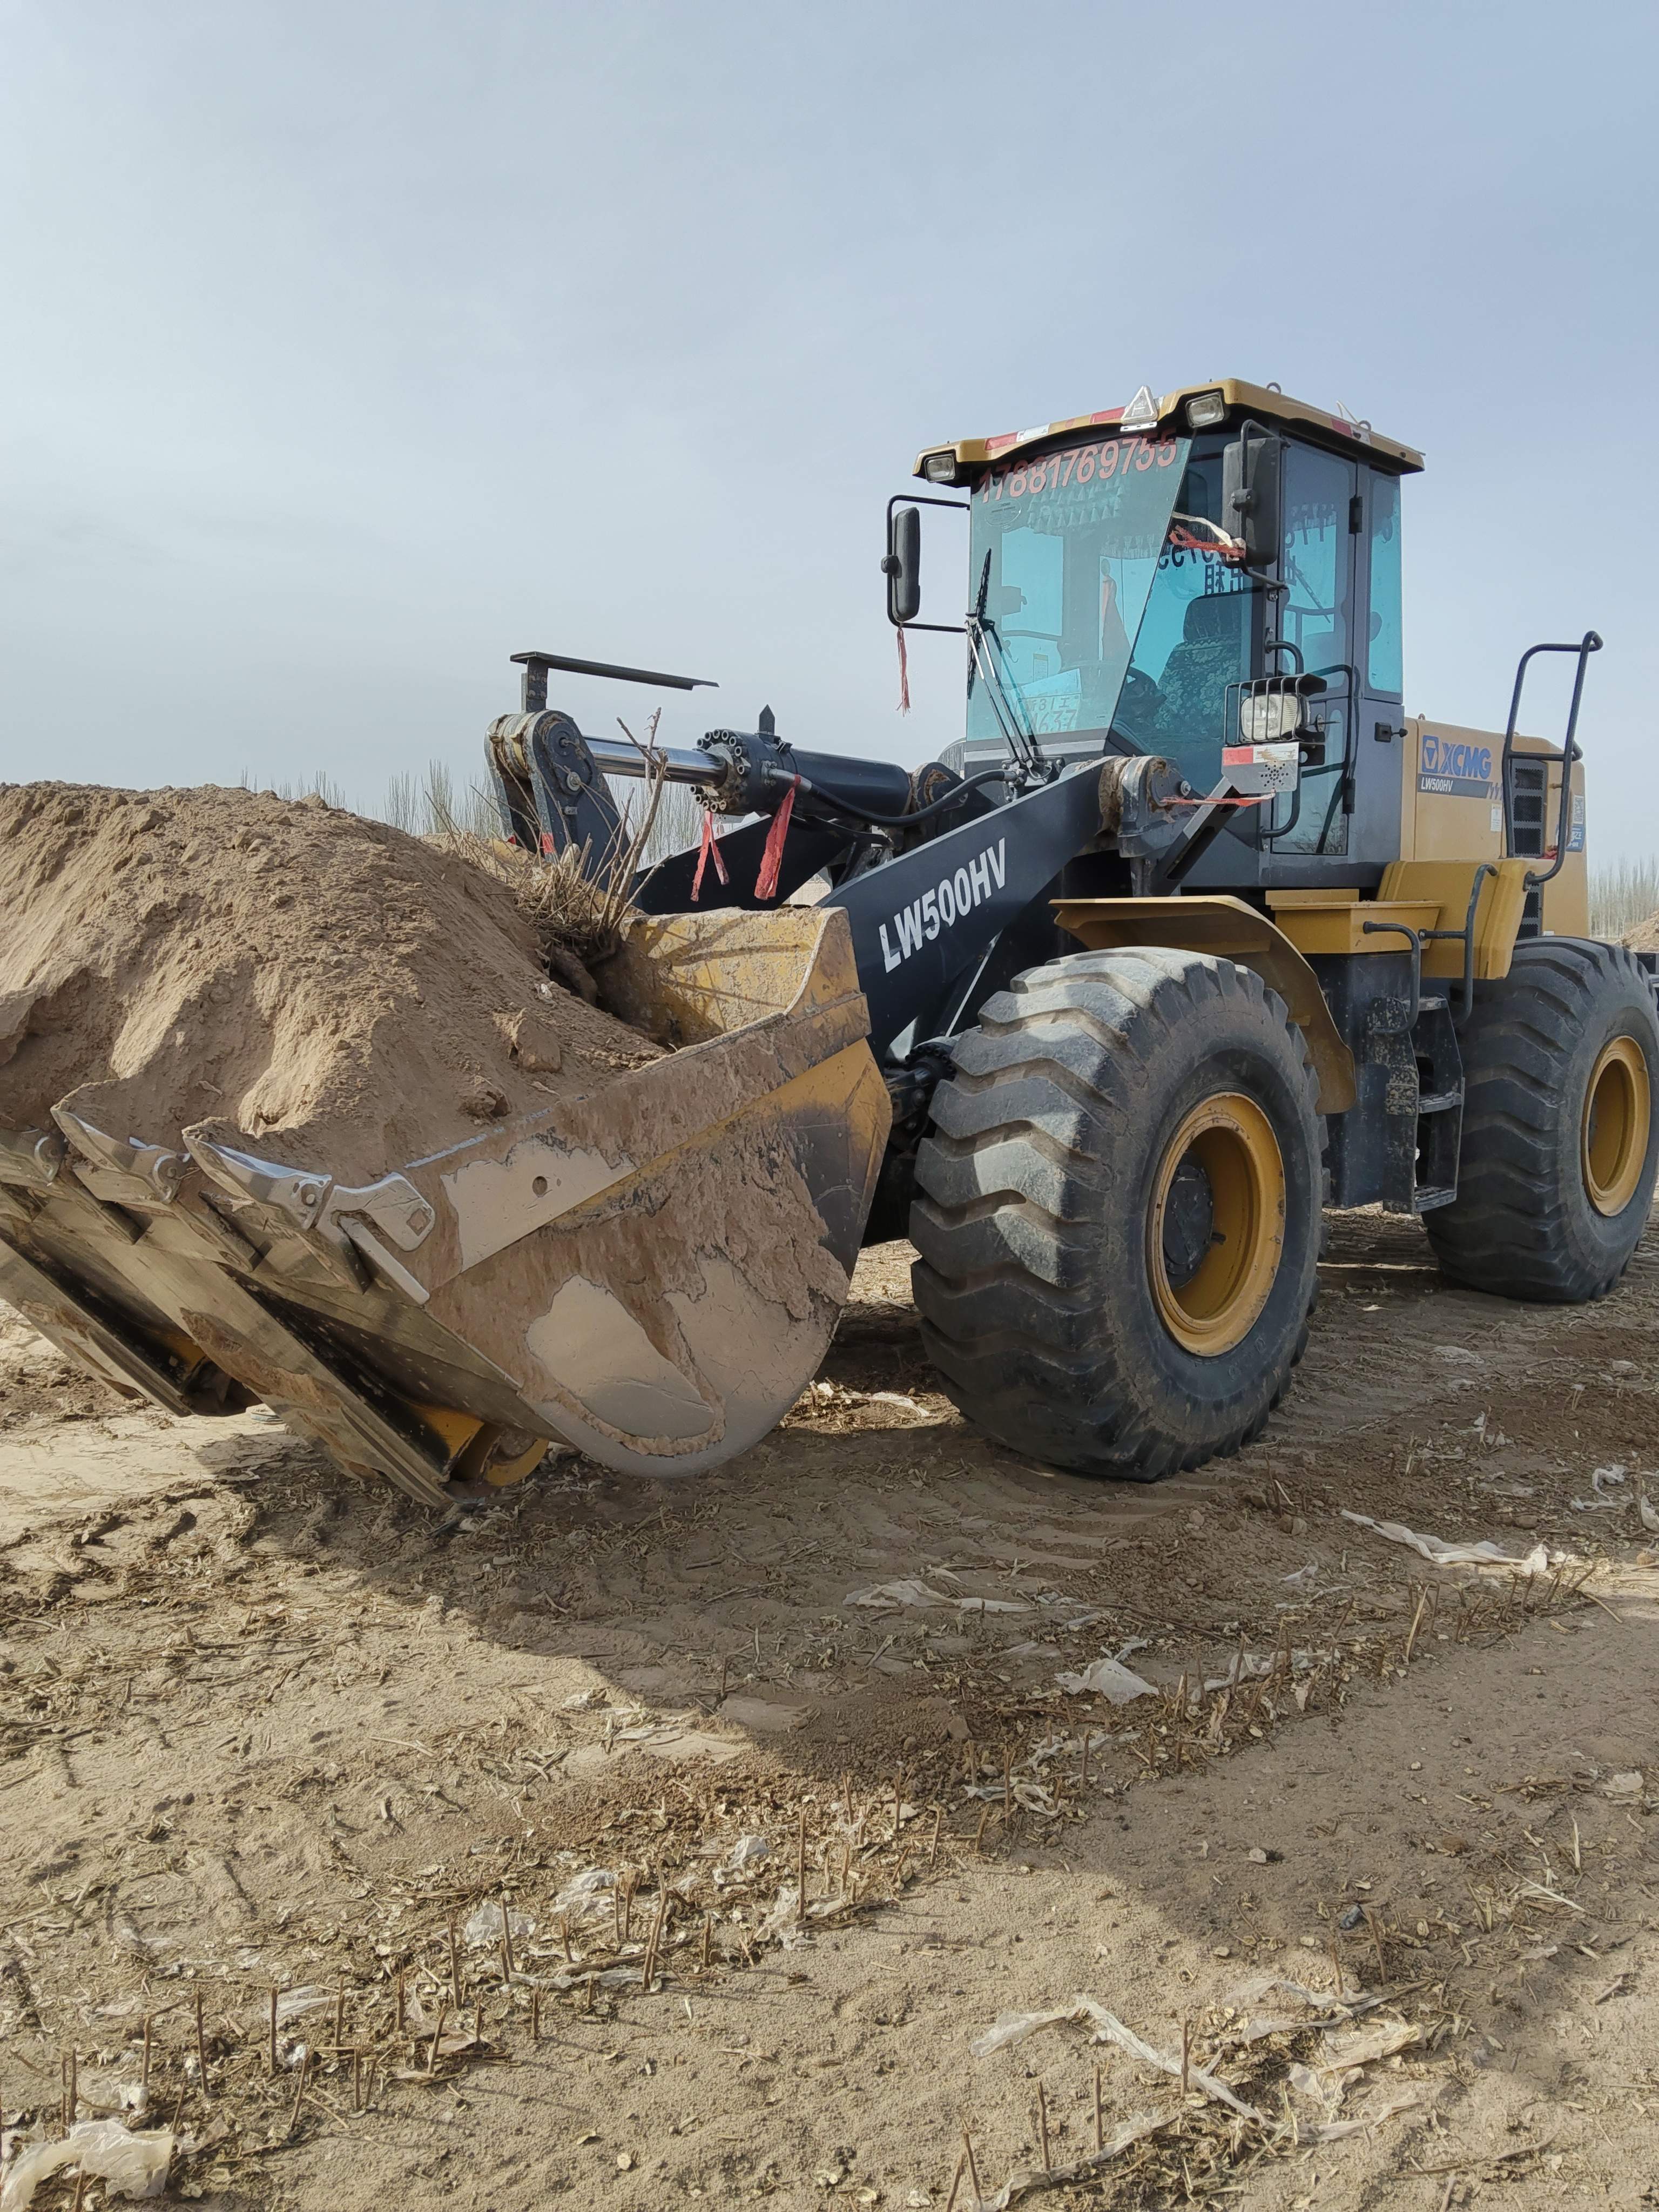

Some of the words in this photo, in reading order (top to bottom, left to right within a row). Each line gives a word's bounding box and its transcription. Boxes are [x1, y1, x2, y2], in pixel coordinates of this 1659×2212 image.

[979, 426, 1177, 503] 17881769755
[1421, 777, 1453, 792] LW500HV
[1439, 742, 1492, 779] XCMG
[879, 837, 1005, 973] LW500HV
